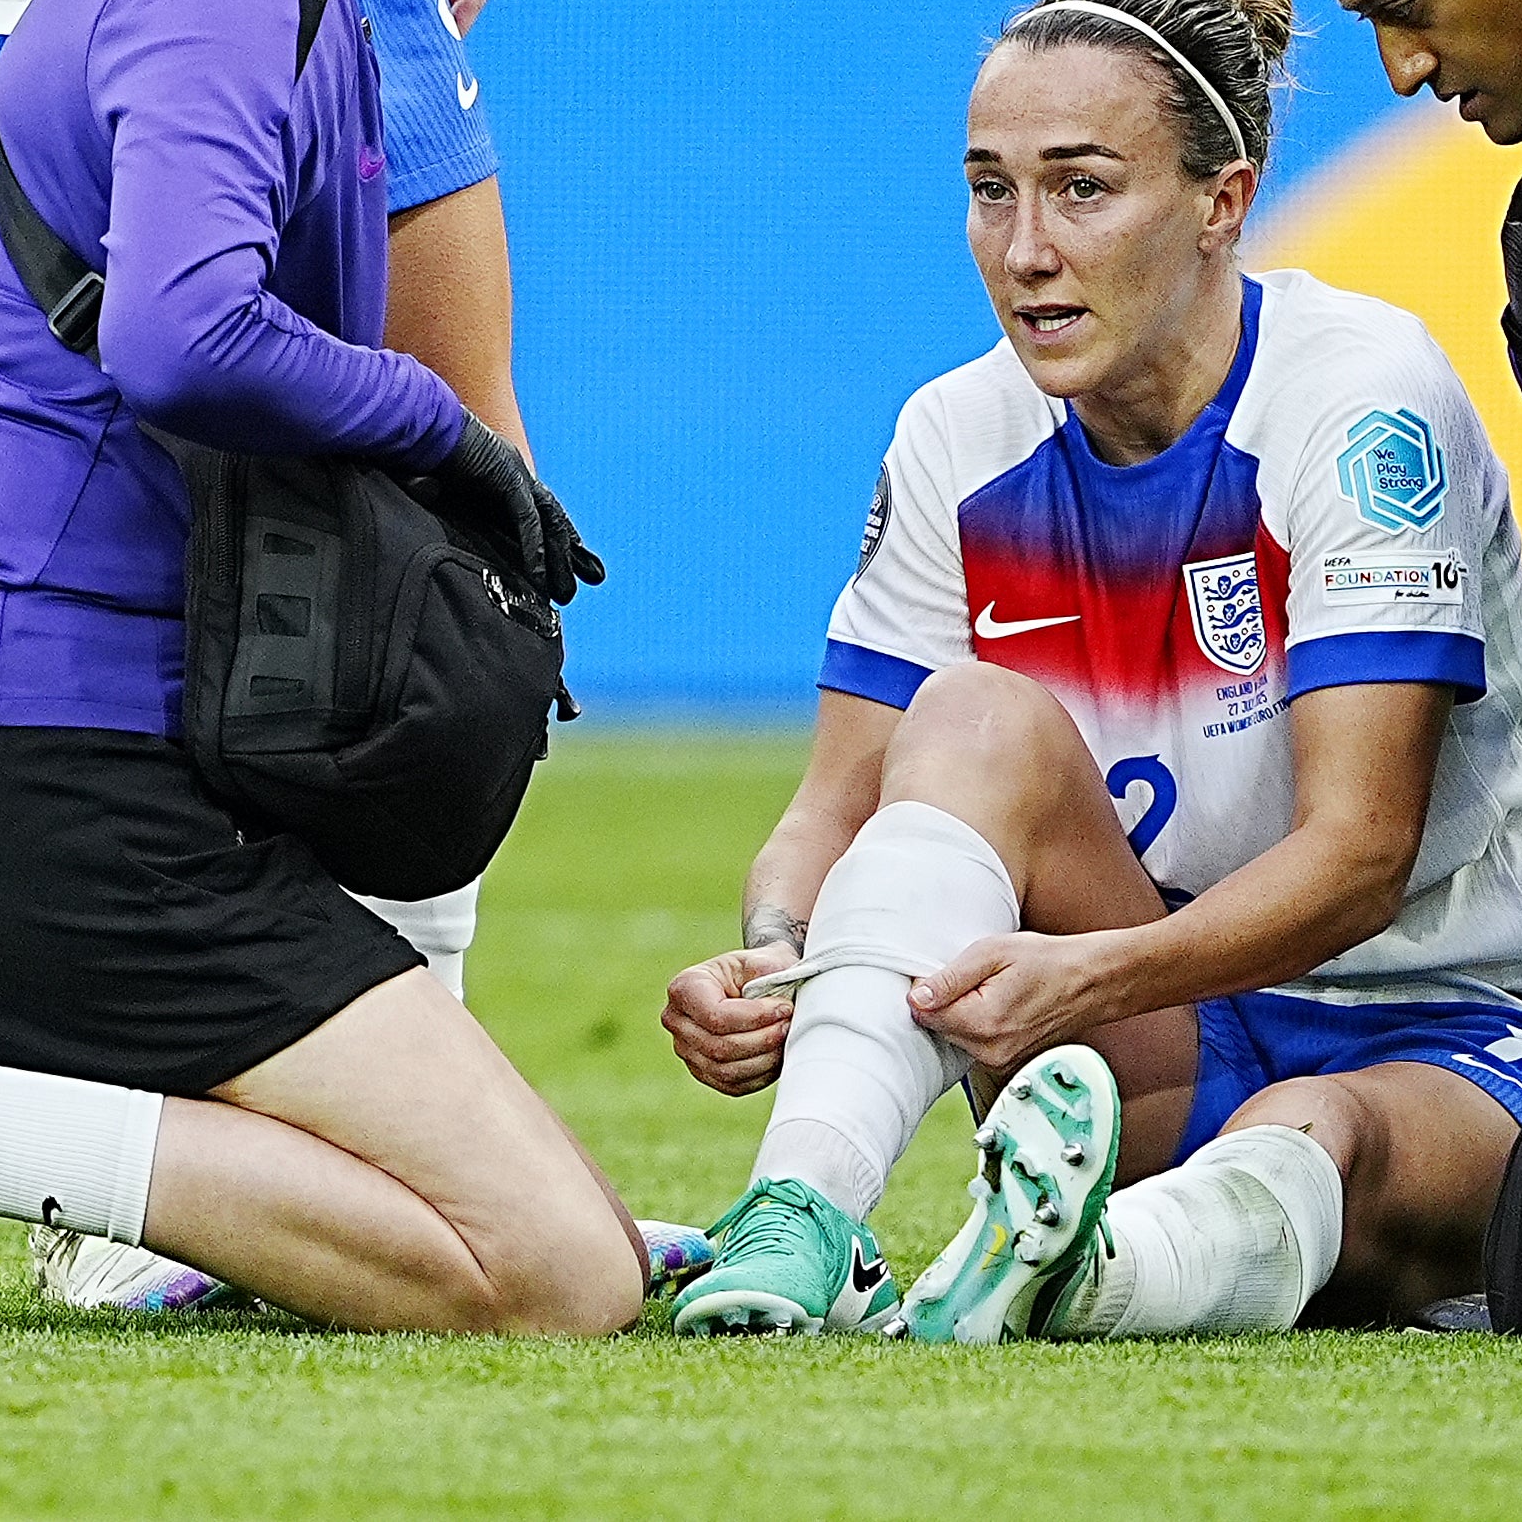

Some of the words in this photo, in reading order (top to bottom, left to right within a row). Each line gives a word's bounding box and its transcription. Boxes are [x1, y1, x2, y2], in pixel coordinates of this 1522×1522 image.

[1373, 448, 1395, 460] We
[1376, 462, 1407, 477] Play
[1379, 477, 1424, 491] Strong
[1324, 557, 1351, 567] UEFA
[1325, 570, 1429, 587] FOUNDATION
[1216, 681, 1253, 700] ENGLAND
[1227, 703, 1238, 716] 27
[1203, 722, 1227, 738] UEFA
[1105, 754, 1177, 859] 2
